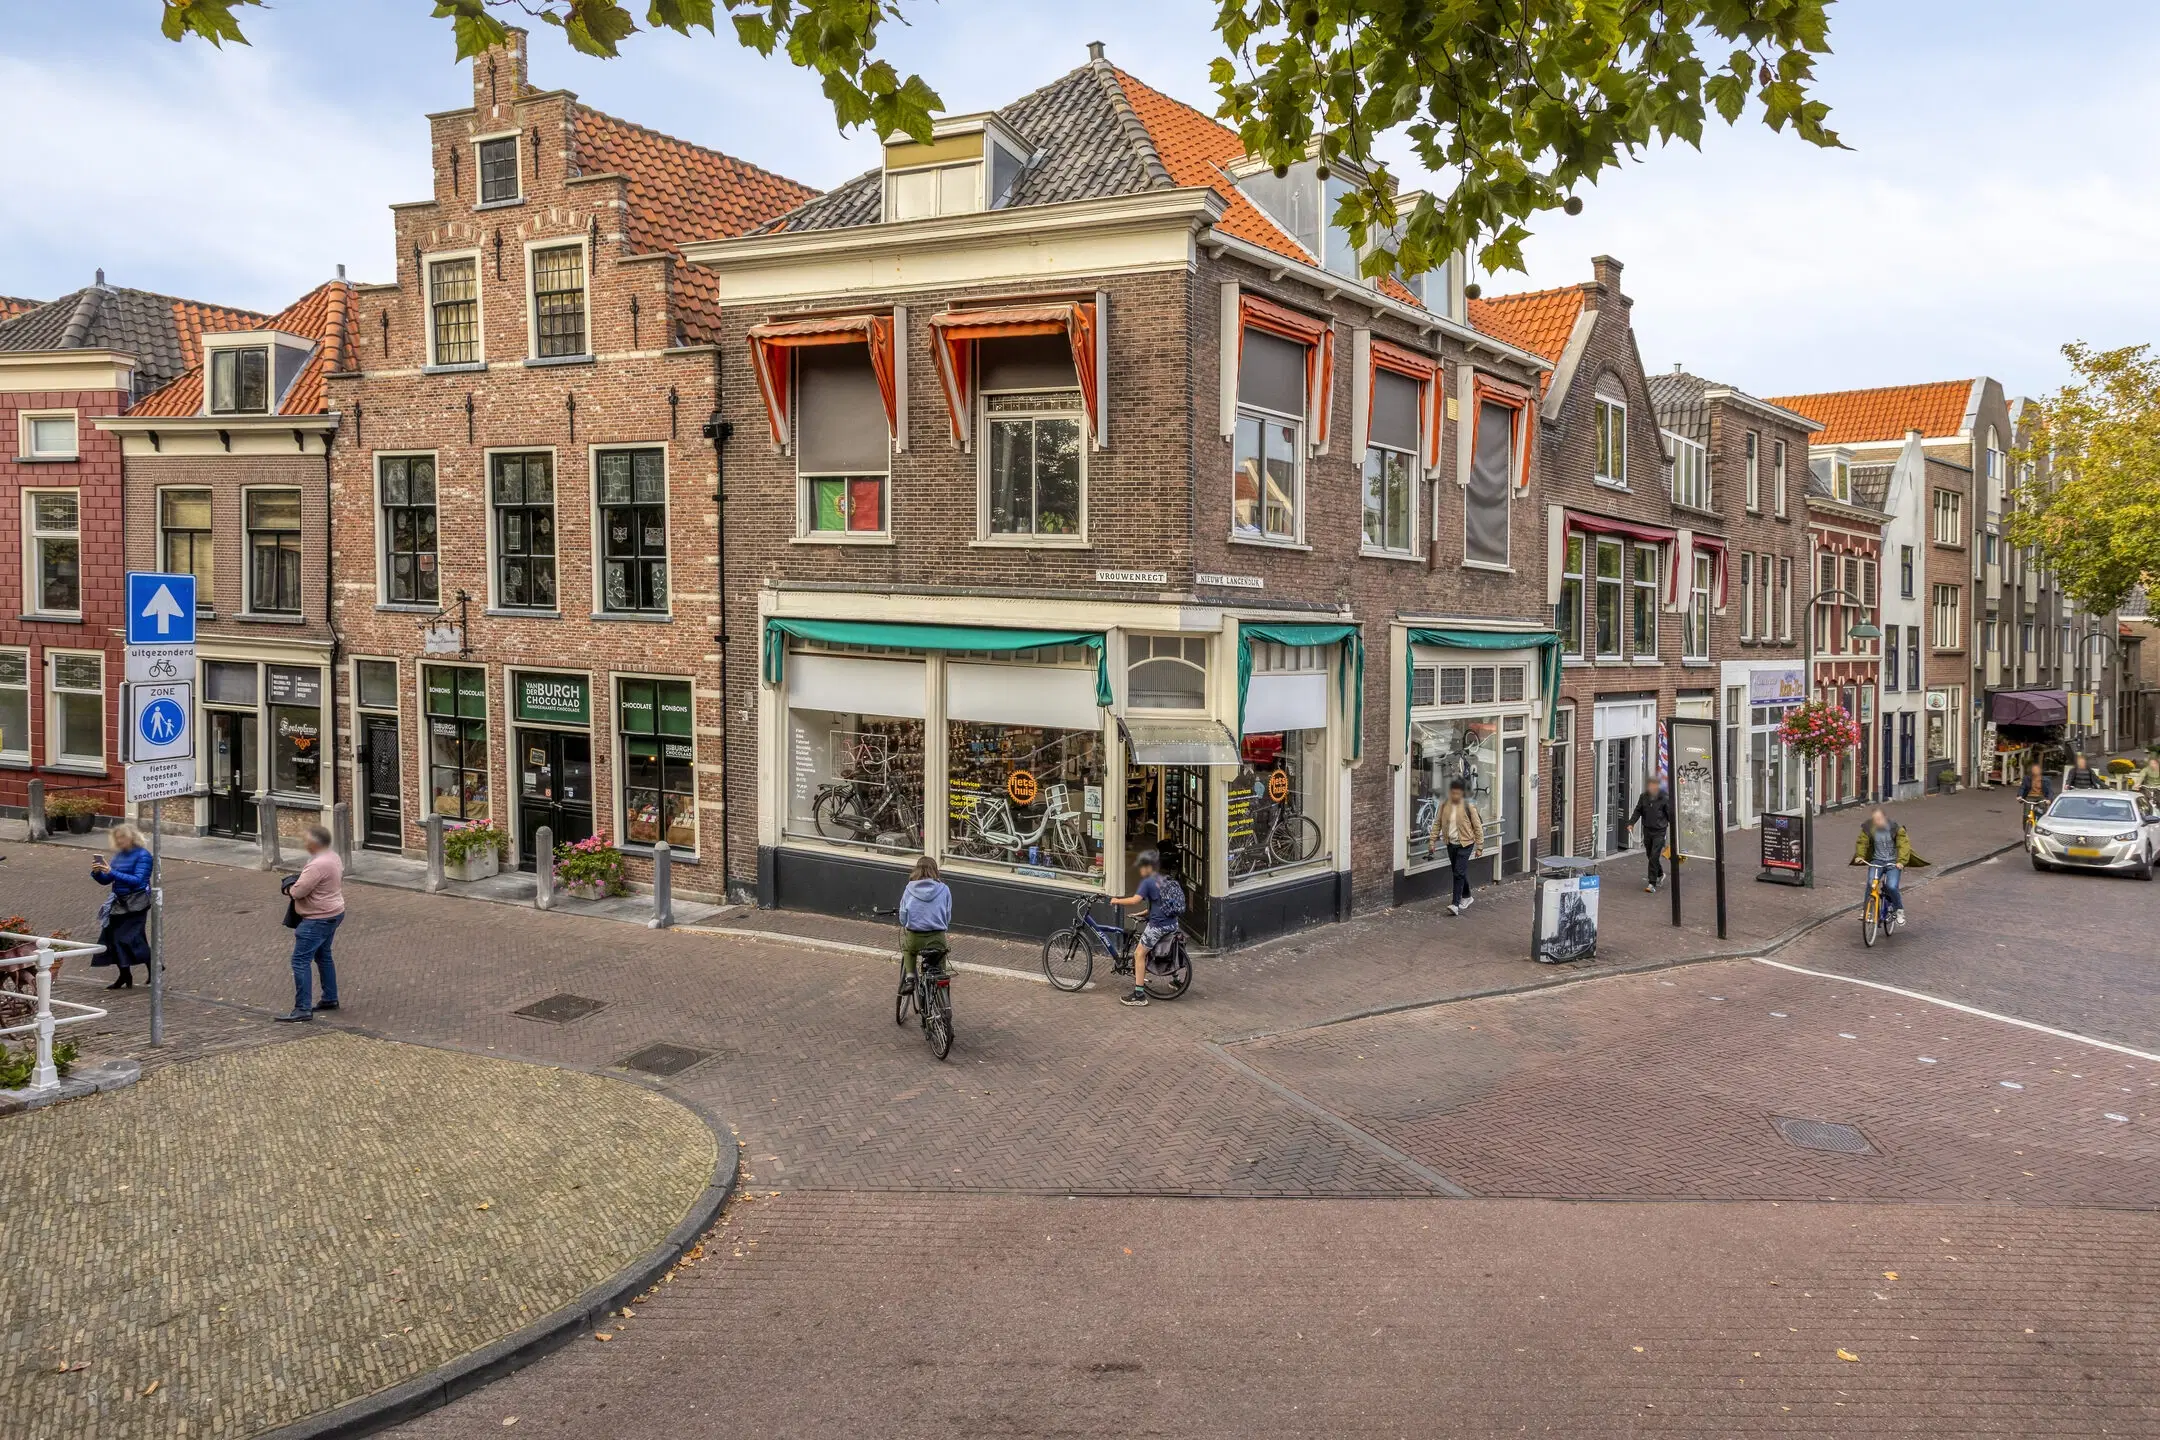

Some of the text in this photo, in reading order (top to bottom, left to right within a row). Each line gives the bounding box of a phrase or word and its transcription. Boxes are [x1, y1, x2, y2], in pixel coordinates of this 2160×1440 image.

[131, 648, 194, 658] uitgezonderd
[150, 687, 176, 697] ZONE
[458, 689, 485, 697] CHOCOLATE
[526, 688, 538, 696] DER
[537, 682, 580, 699] BURGH
[526, 695, 580, 708] CHOCOLAAD
[621, 701, 653, 710] CHOCOLATE
[661, 704, 688, 713] BONBONS
[149, 764, 178, 773] fietsers
[1011, 776, 1034, 787] fiets
[134, 785, 192, 801] snorfietsers niet
[1014, 785, 1034, 796] huis
